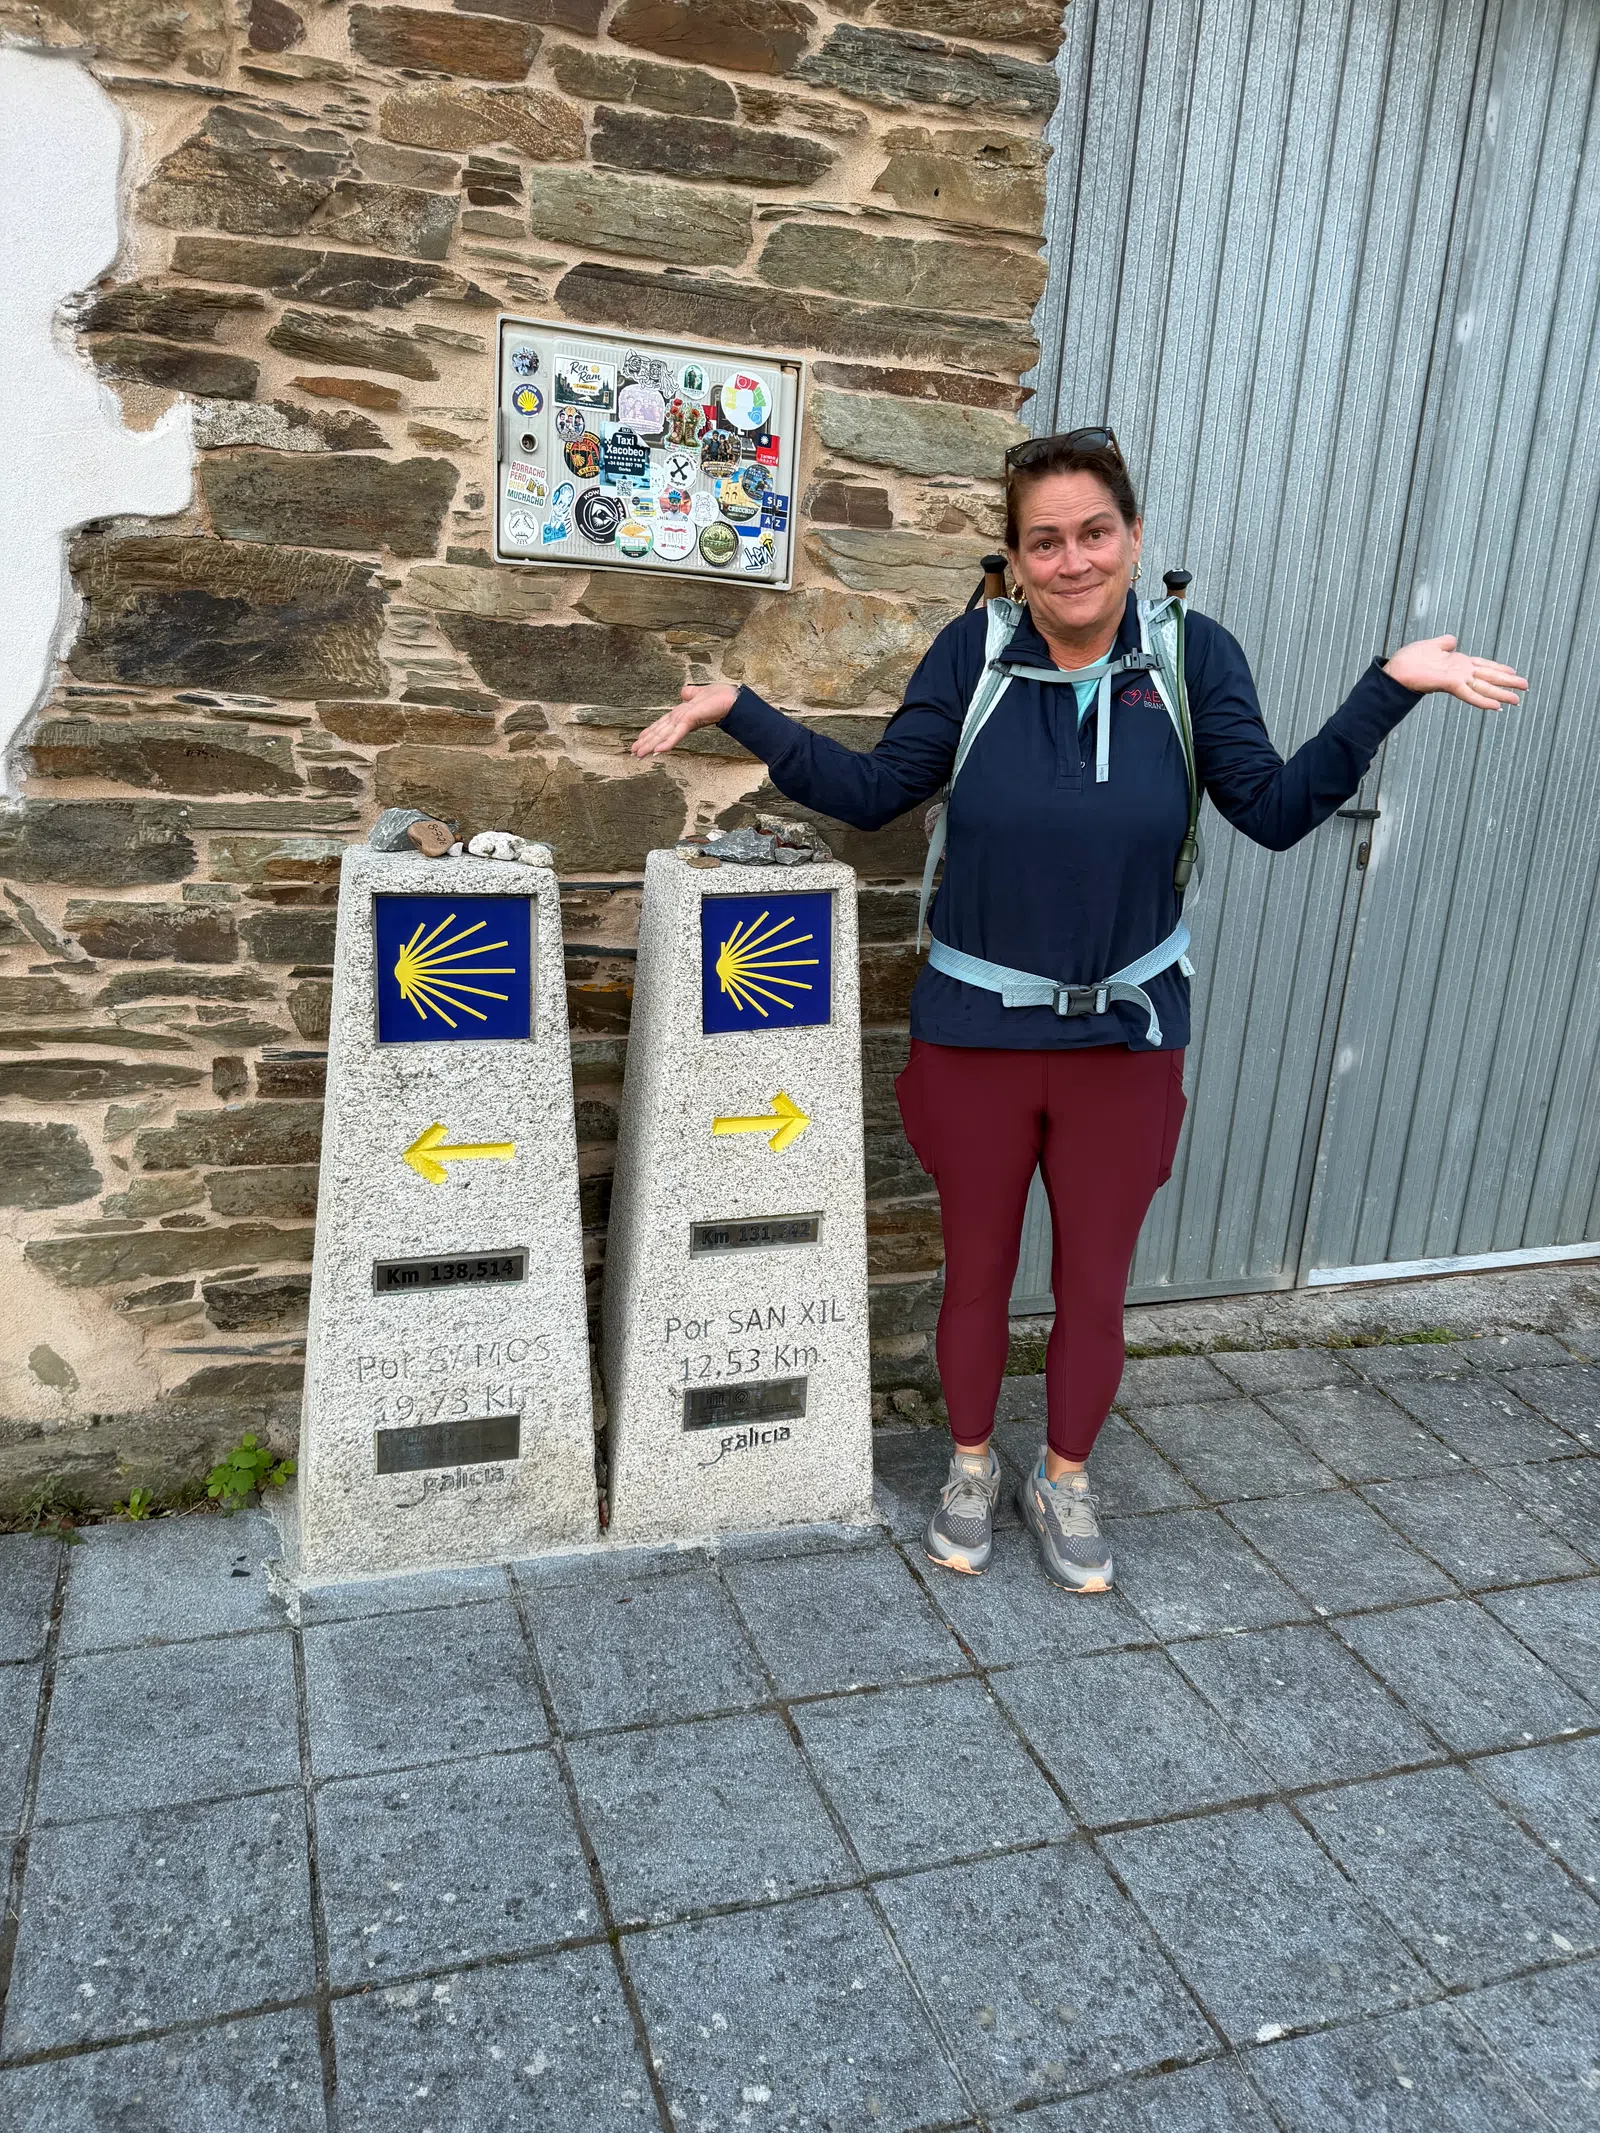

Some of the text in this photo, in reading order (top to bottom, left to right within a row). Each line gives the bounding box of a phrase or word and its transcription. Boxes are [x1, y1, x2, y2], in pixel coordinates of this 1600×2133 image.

[570, 361, 589, 374] Ren
[578, 371, 601, 382] Ram
[616, 434, 635, 446] Taxi
[606, 444, 644, 457] Xacobeo
[509, 471, 527, 482] PERO
[511, 461, 546, 479] BORRACHO
[508, 480, 525, 491] BUEN
[506, 489, 544, 507] MUCHACHO
[1143, 689, 1161, 703] AE
[702, 1229, 730, 1245] Km
[387, 1259, 514, 1285] Km 138,514
[665, 1299, 846, 1343] Por SAN XIL
[358, 1353, 416, 1383] Por
[679, 1348, 760, 1382] 12,53
[697, 1427, 791, 1467] galicia
[396, 1465, 505, 1509] galicia
